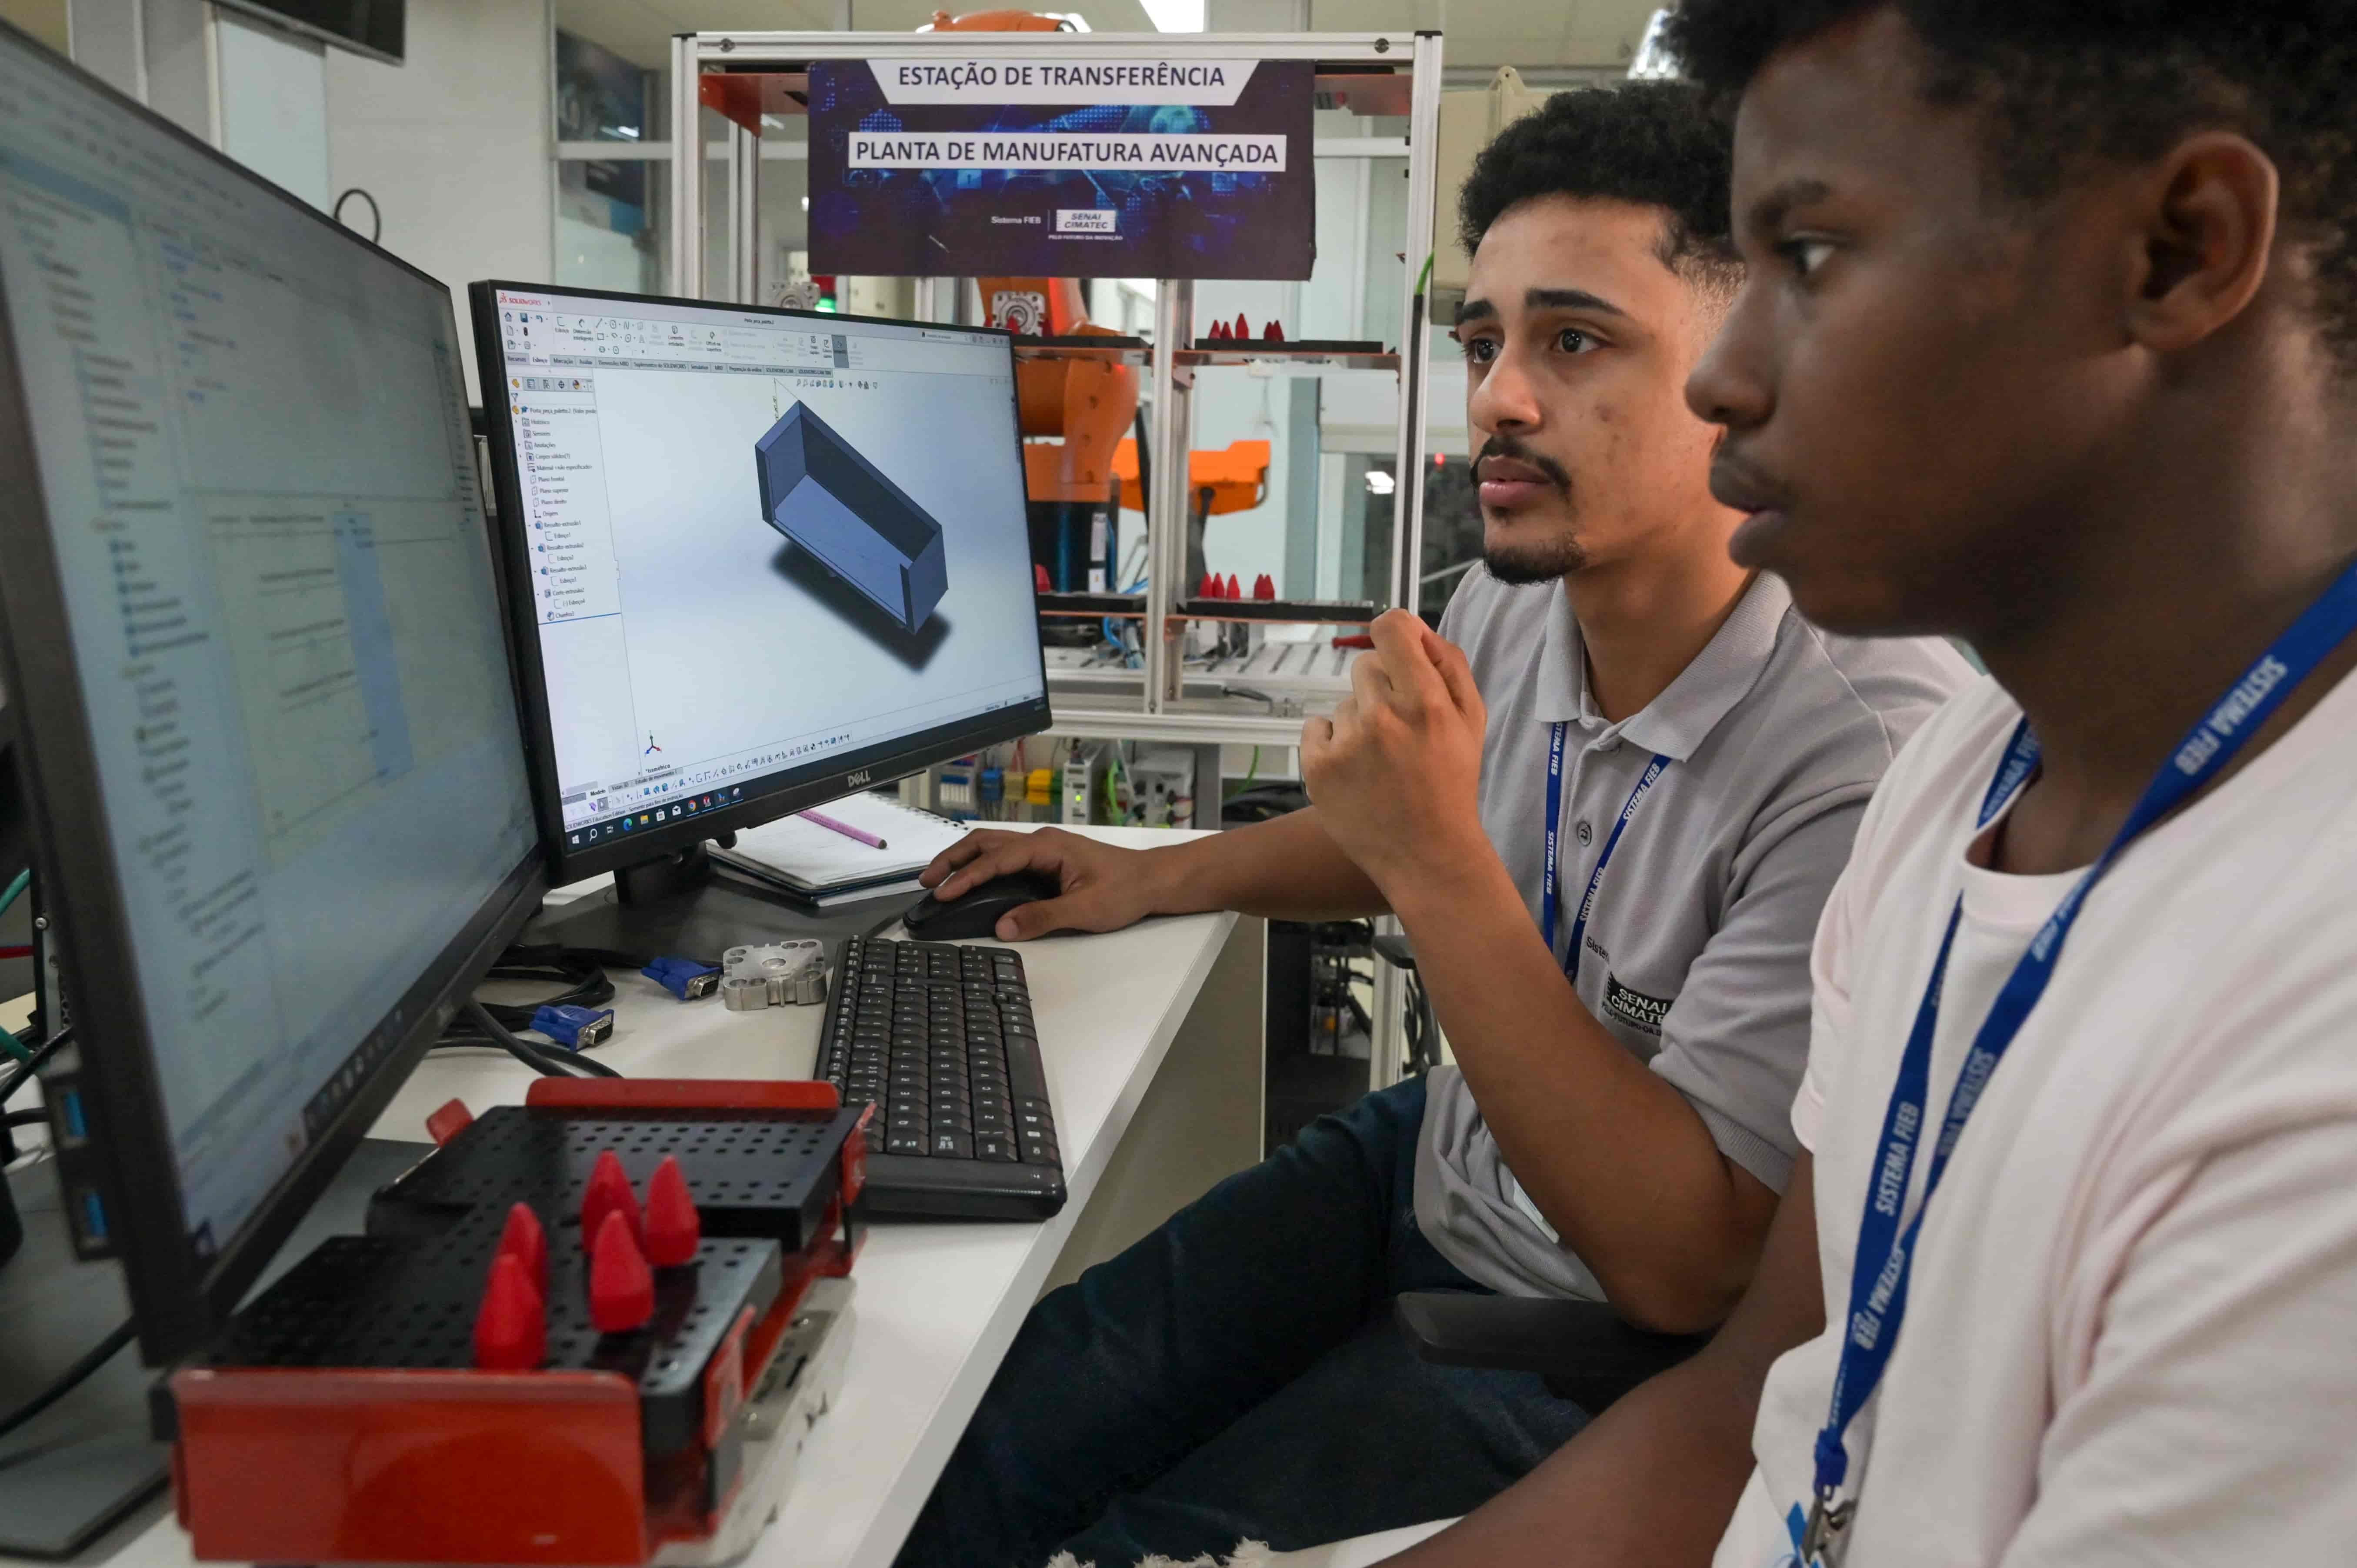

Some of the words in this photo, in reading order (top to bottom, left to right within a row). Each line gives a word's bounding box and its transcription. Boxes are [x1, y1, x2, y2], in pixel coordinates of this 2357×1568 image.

[899, 62, 997, 90] ESTAÇÃO
[1005, 67, 1032, 86] DE
[1040, 62, 1225, 86] TRANSFERÊNCIA
[857, 141, 940, 160] PLANTA
[948, 142, 975, 160] DE
[983, 142, 1143, 162] MANUFATURA
[1150, 143, 1278, 168] AVANÇADA
[590, 788, 606, 796] Modelo
[847, 770, 871, 787] DELL
[1622, 783, 1648, 820] SISTEMA
[1645, 762, 1660, 785] FIEB
[1611, 995, 1665, 1023] CIMATE
[1619, 989, 1667, 1013] SENAI
[1875, 1141, 1910, 1217] SISTEMA
[1893, 1101, 1920, 1142] FIEB
[1867, 1244, 1906, 1315] SISTEMA
[1854, 1308, 1881, 1351] FIEB
